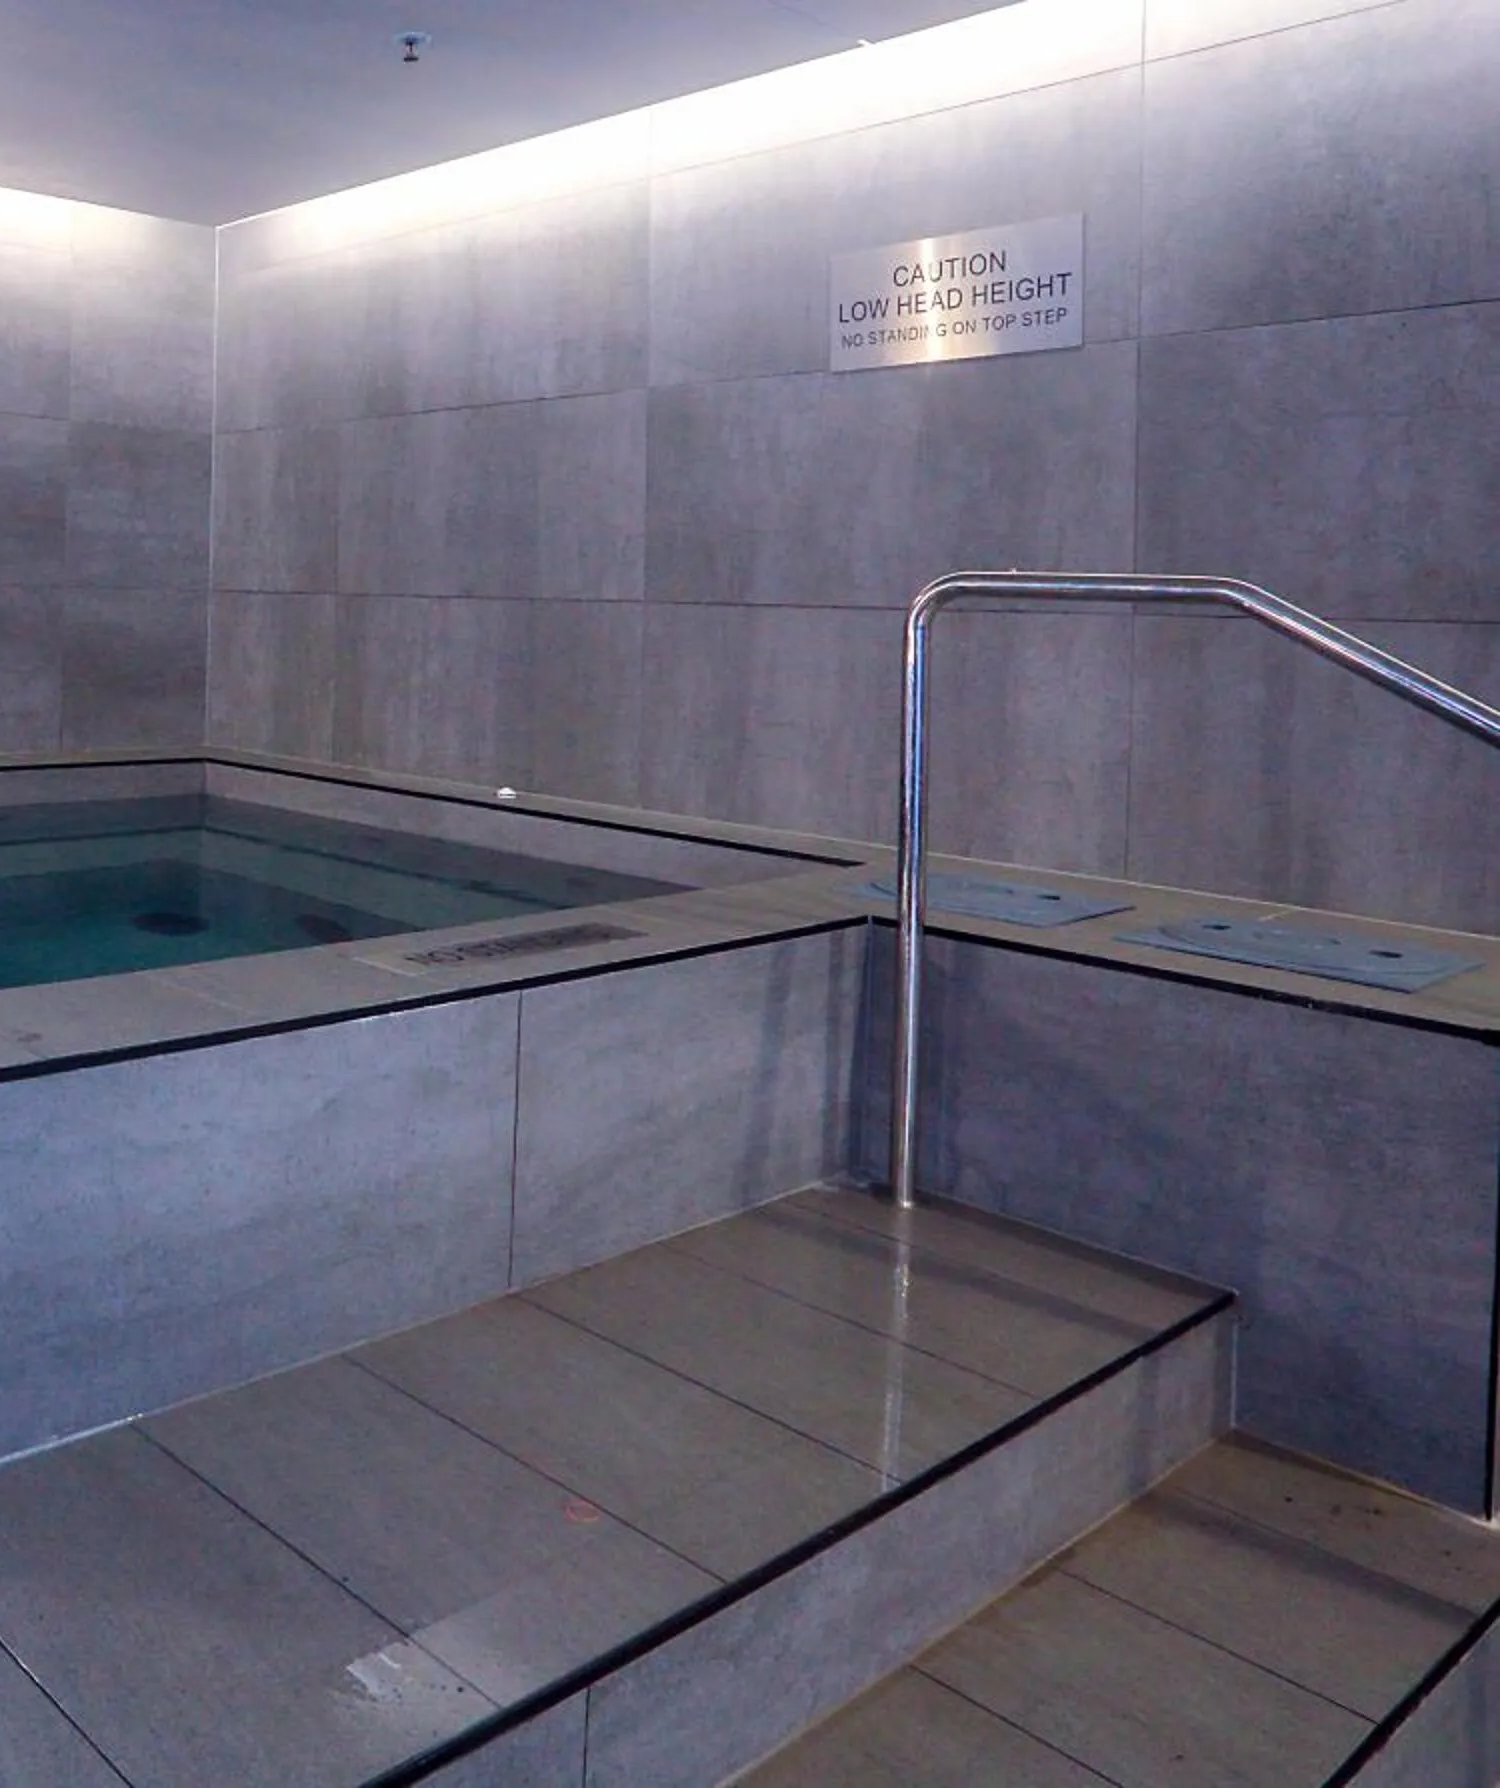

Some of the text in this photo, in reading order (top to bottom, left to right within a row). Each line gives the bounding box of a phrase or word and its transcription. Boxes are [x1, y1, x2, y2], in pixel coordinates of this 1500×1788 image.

[893, 250, 1007, 287] CAUTION
[838, 272, 1072, 324] LOW HEAD HEIGHT
[841, 332, 865, 350] NO
[952, 319, 977, 335] ON
[982, 315, 1017, 334] TOP
[1022, 308, 1067, 328] STEP
